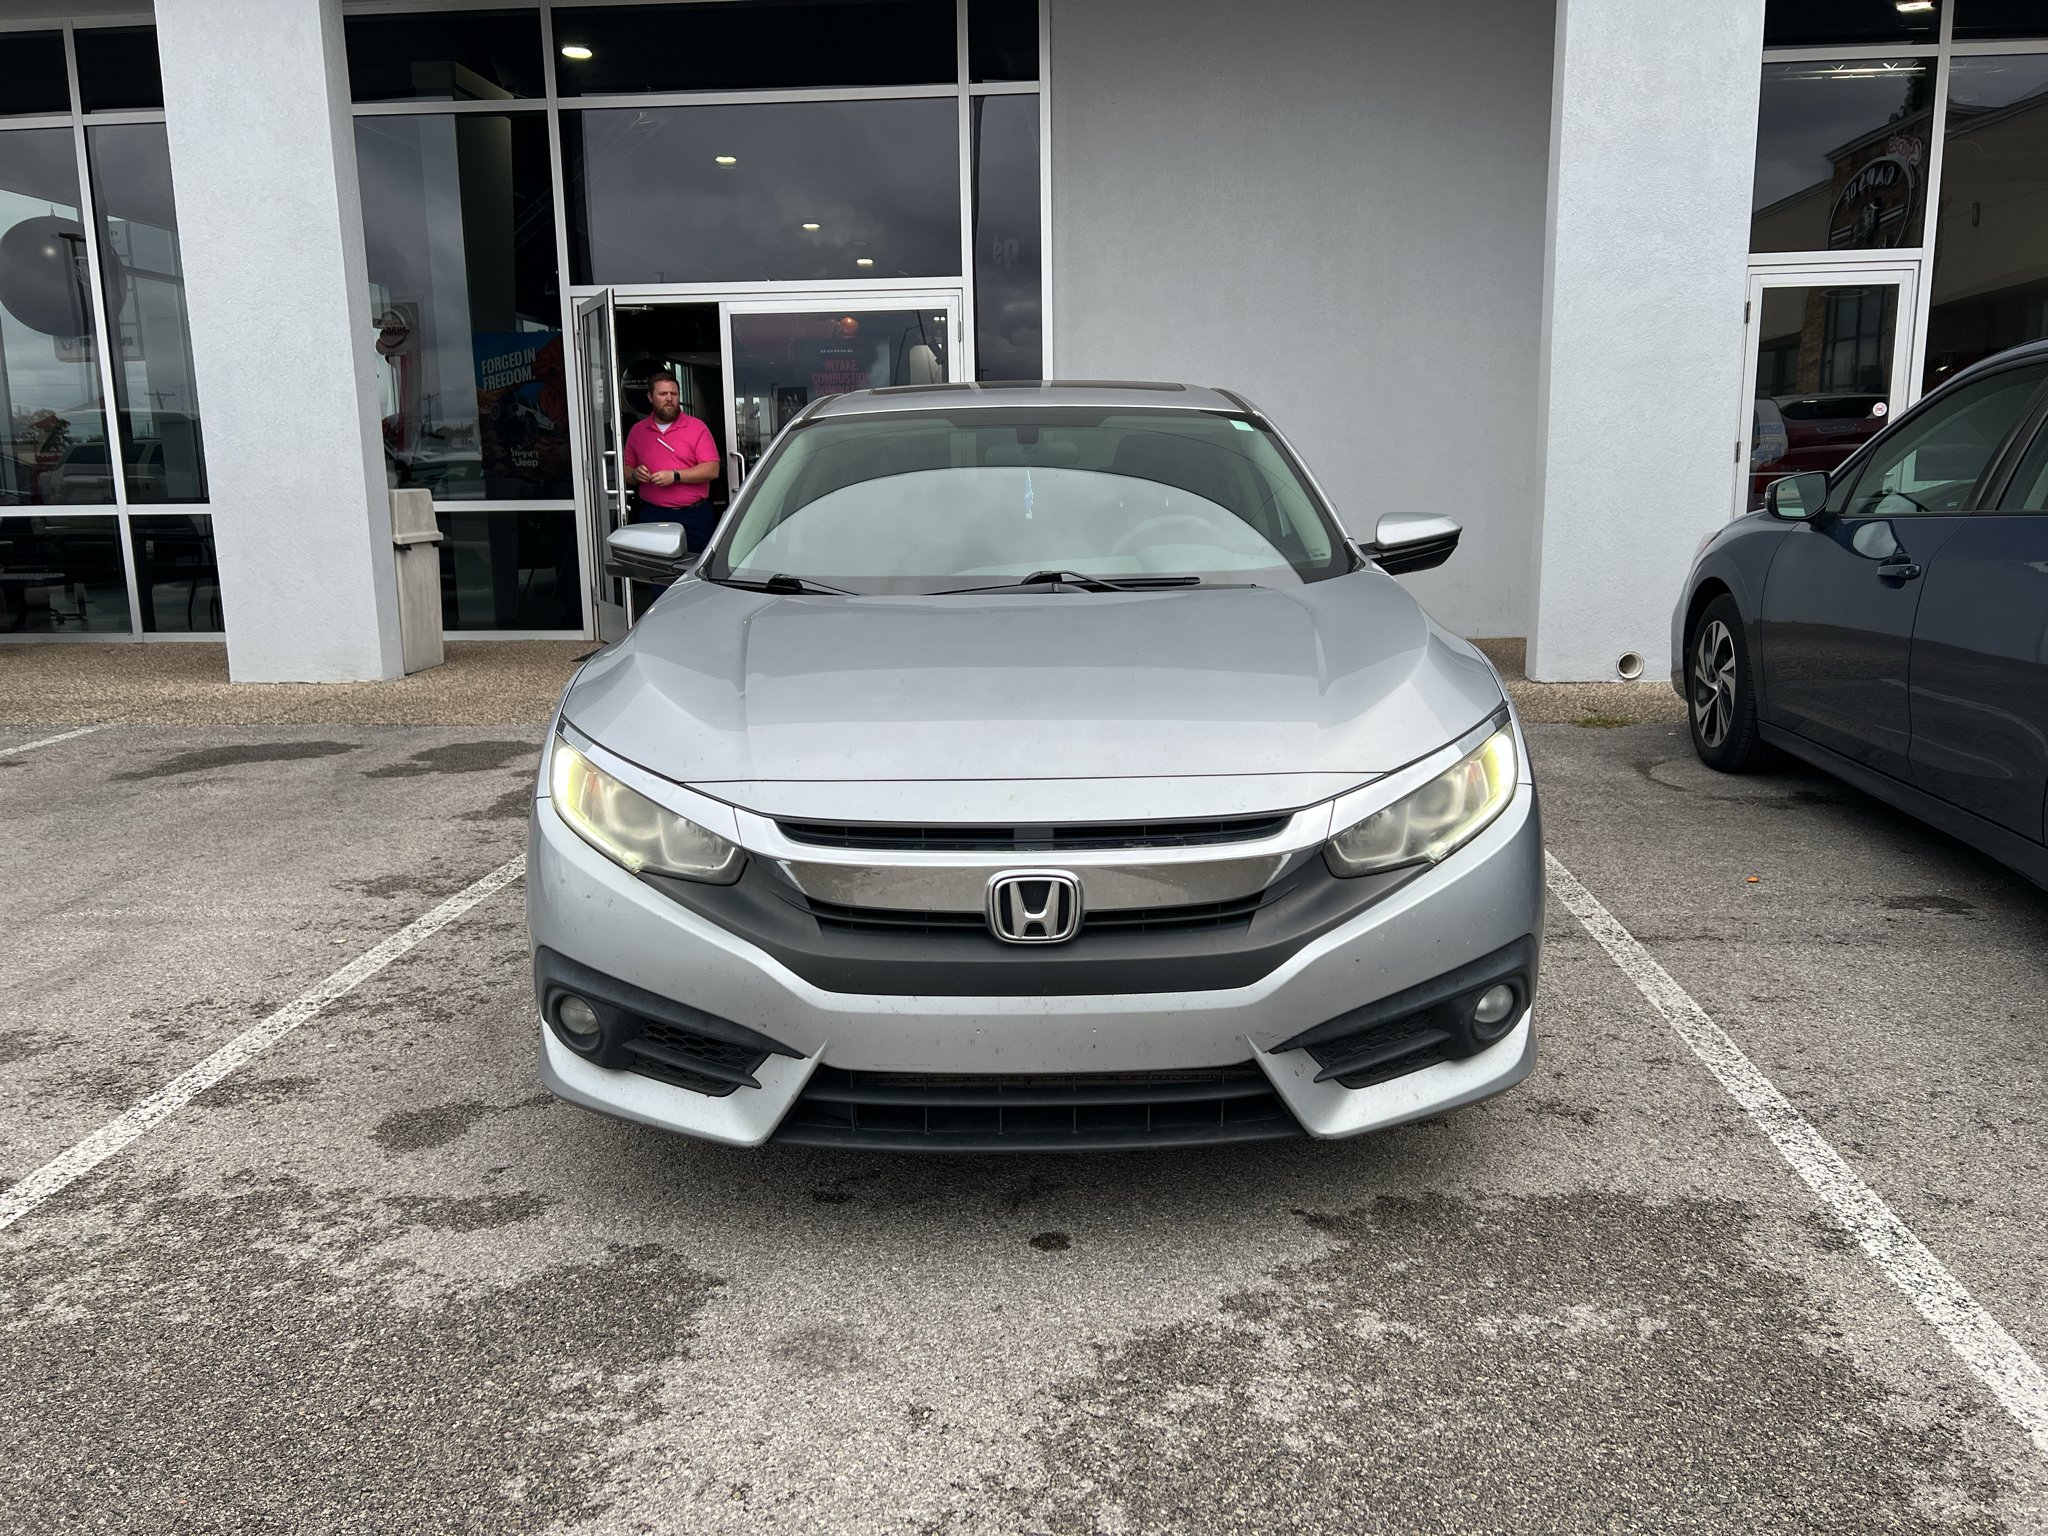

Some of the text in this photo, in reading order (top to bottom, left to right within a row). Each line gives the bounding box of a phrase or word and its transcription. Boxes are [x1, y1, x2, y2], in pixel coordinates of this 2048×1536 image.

[481, 346, 537, 376] FORGED IN
[482, 364, 537, 392] FREEDOM.
[515, 457, 539, 469] Jeep
